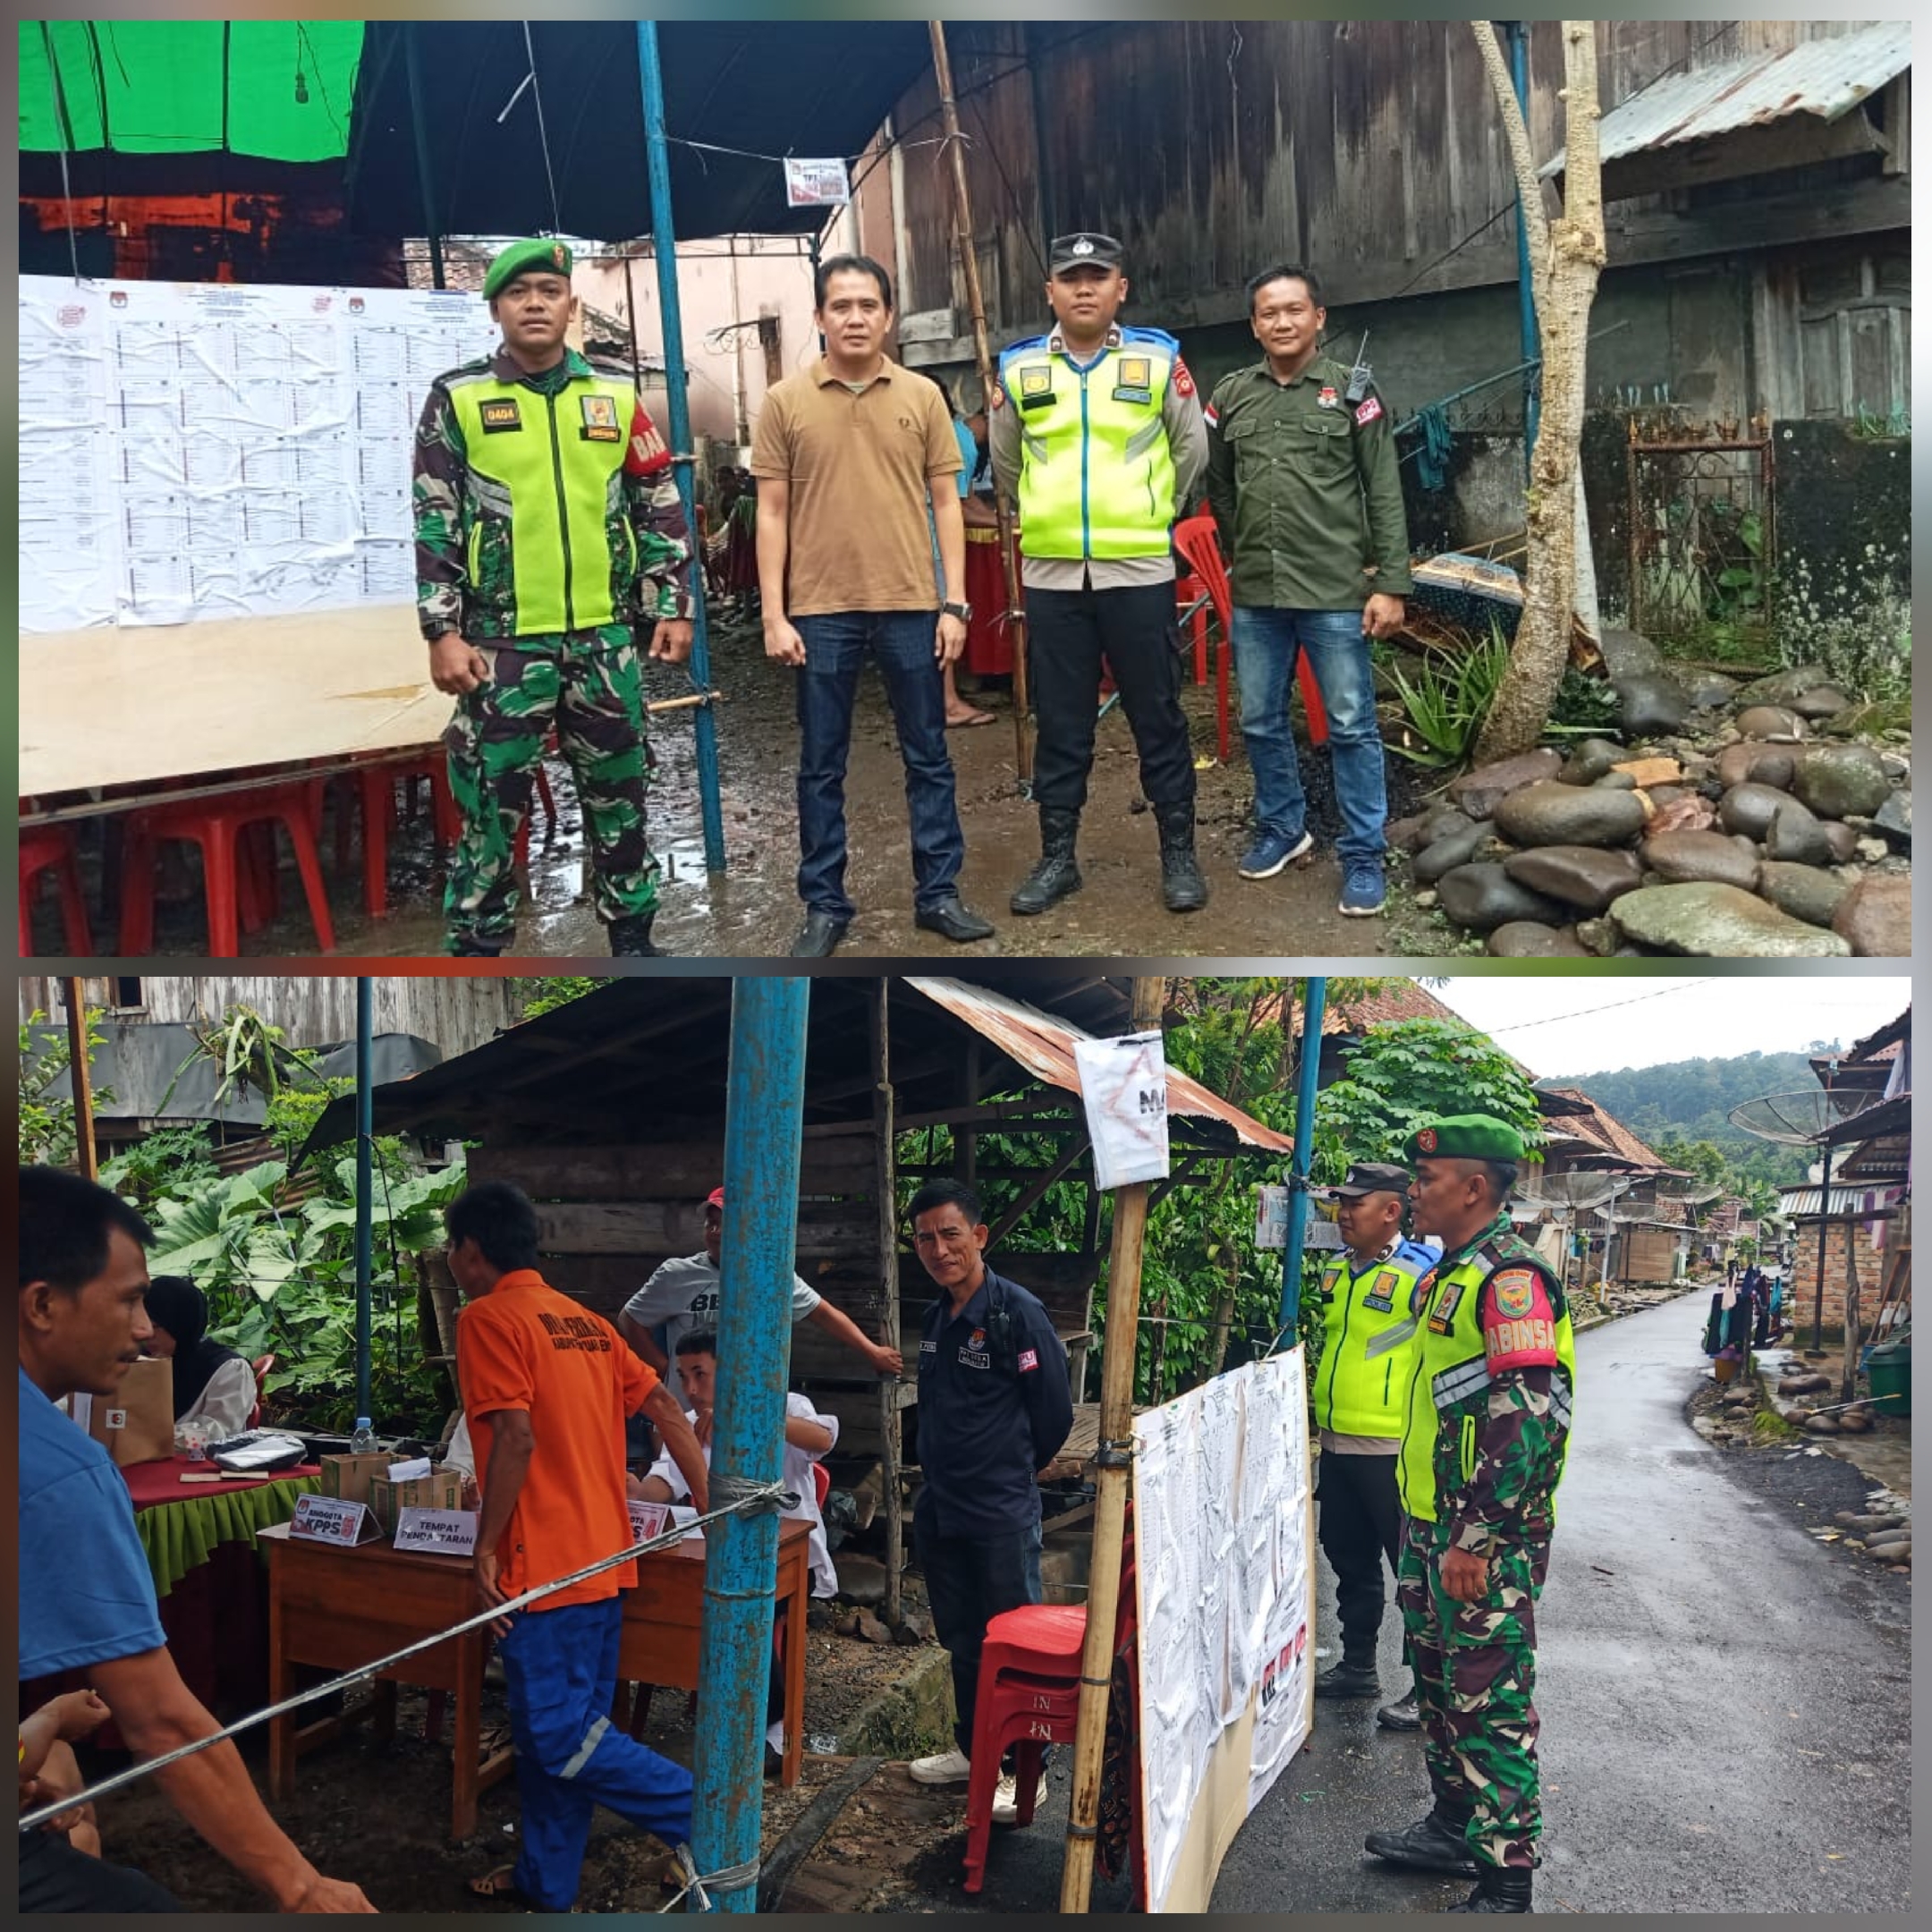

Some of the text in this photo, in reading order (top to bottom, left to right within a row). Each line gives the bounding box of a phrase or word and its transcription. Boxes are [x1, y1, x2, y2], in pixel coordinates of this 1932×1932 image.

[306, 1518, 342, 1536] KPPS
[419, 1521, 460, 1533] TEMPAT
[401, 1530, 473, 1545] PENDATARAN
